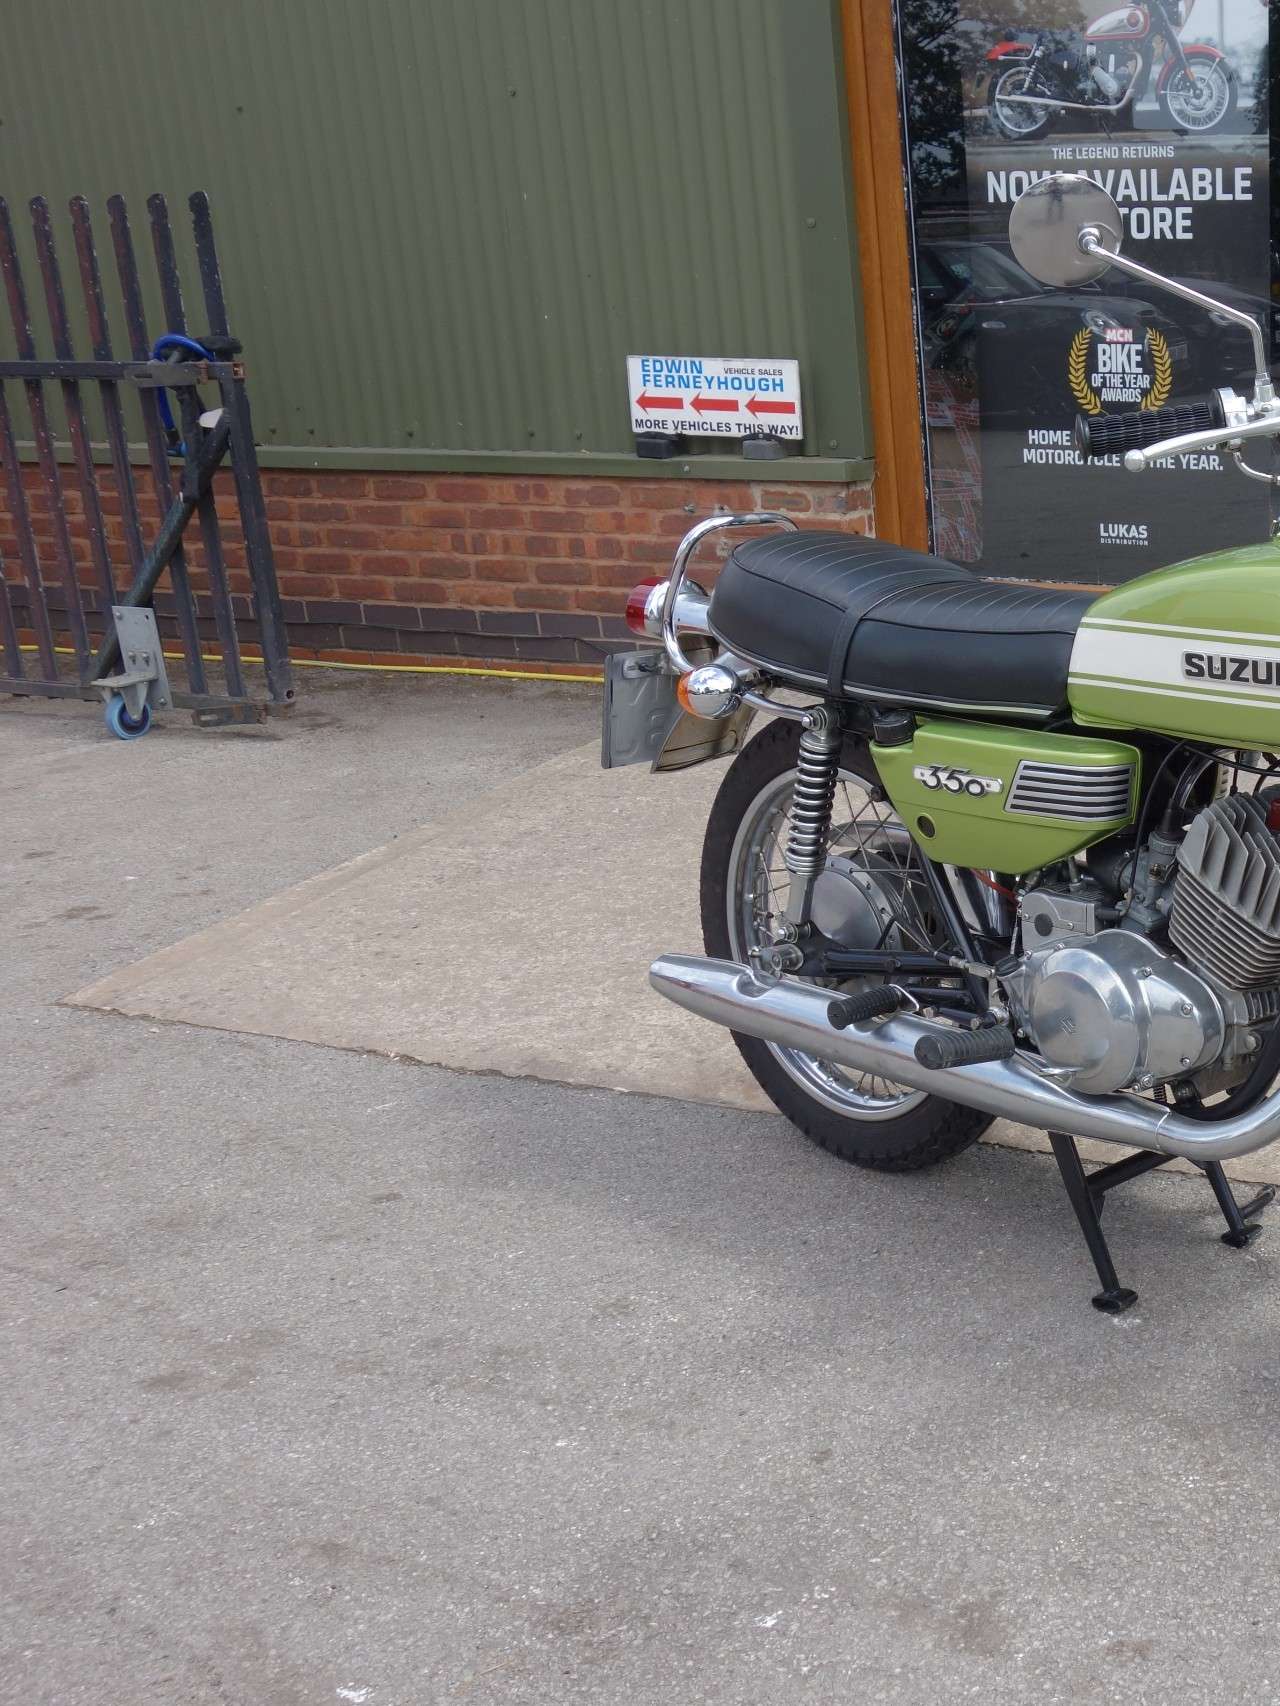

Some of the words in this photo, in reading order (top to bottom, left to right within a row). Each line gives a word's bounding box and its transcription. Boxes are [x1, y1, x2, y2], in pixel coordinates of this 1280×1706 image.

[1051, 147, 1073, 160] THE
[1075, 147, 1119, 159] LEGEND
[1122, 146, 1175, 158] RETURNS
[986, 170, 1063, 203] NO
[1077, 167, 1253, 202] VAILABLE
[1105, 328, 1133, 342] MCN
[641, 358, 703, 374] EDWIN
[1097, 343, 1143, 374] BIKE
[723, 367, 756, 376] VEHICLE
[758, 368, 783, 377] SALES
[642, 373, 784, 393] FERNEYHOUGH
[1091, 373, 1103, 387] OF
[1104, 373, 1123, 388] THE
[1124, 374, 1151, 389] YEAR
[1101, 387, 1142, 403] AWARDS
[634, 418, 668, 430] MORE
[673, 420, 732, 433] VEHICLES
[735, 422, 765, 434] THIS
[767, 424, 800, 437] WAY!
[1028, 429, 1071, 446] HOME
[1179, 454, 1224, 471] YEAR.
[1099, 522, 1148, 539] LUKAS
[1100, 538, 1149, 546] DISTRIBUTION
[920, 764, 986, 797] 350
